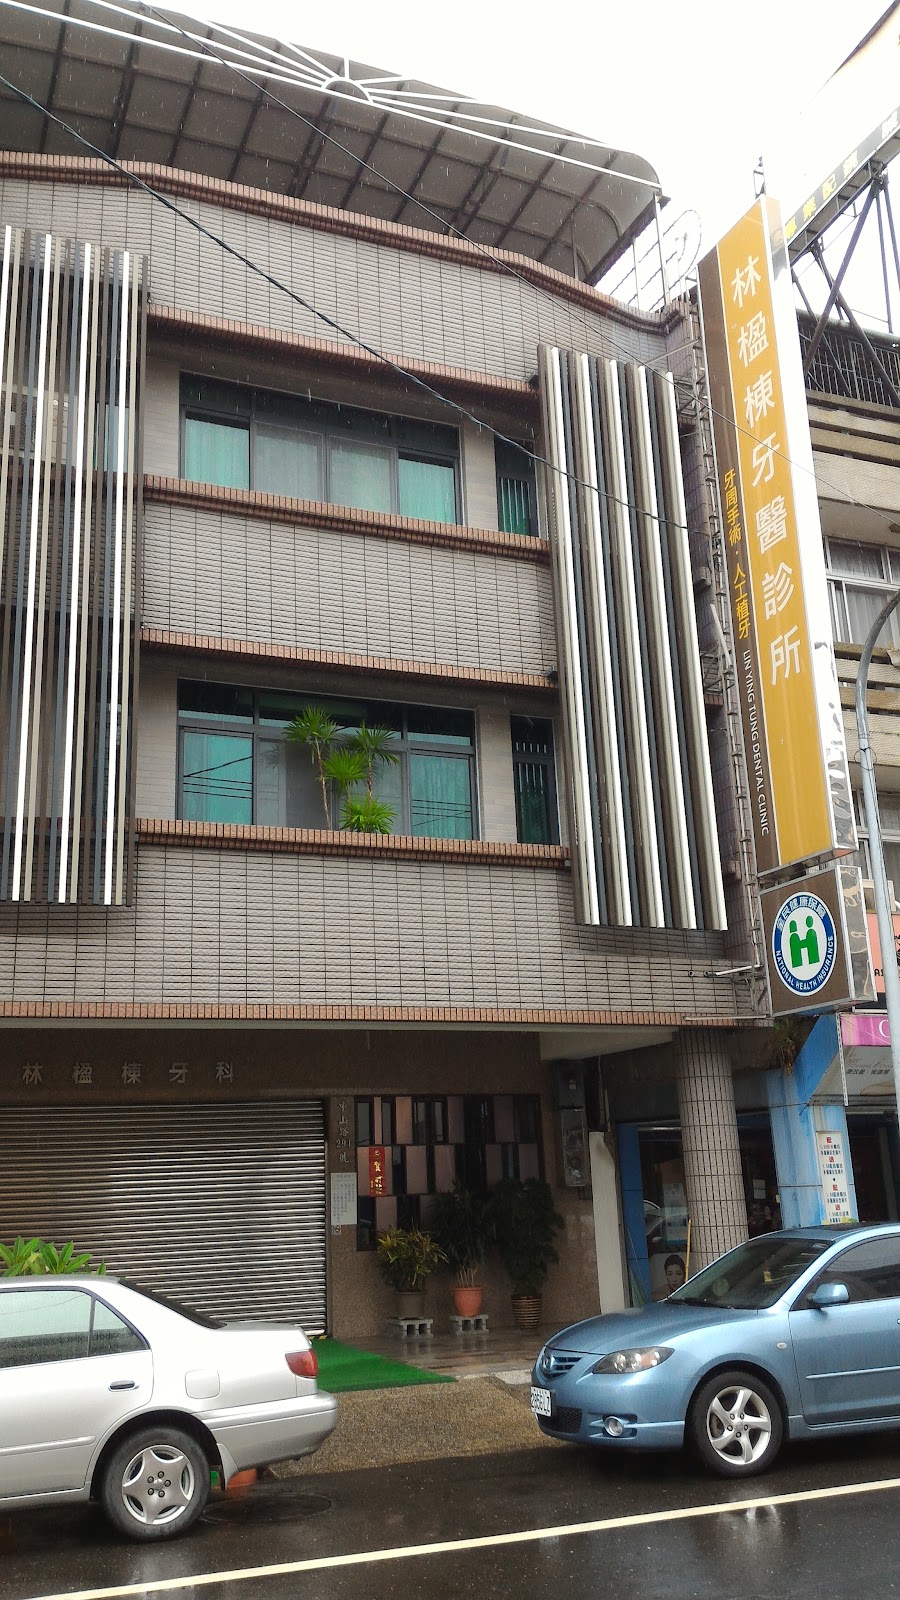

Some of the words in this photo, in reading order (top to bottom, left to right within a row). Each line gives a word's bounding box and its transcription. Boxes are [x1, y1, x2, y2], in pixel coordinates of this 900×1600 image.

[730, 254, 801, 685] 林楹棟牙醫診所
[743, 649, 752, 670] LIN
[744, 671, 755, 702] YING
[747, 704, 759, 742] TUNG
[752, 743, 764, 793] DENTAL
[758, 794, 770, 836] CLINIC
[775, 950, 795, 986] NATIONAL
[795, 979, 818, 991] HEALTH
[816, 935, 835, 984] INSURANCE
